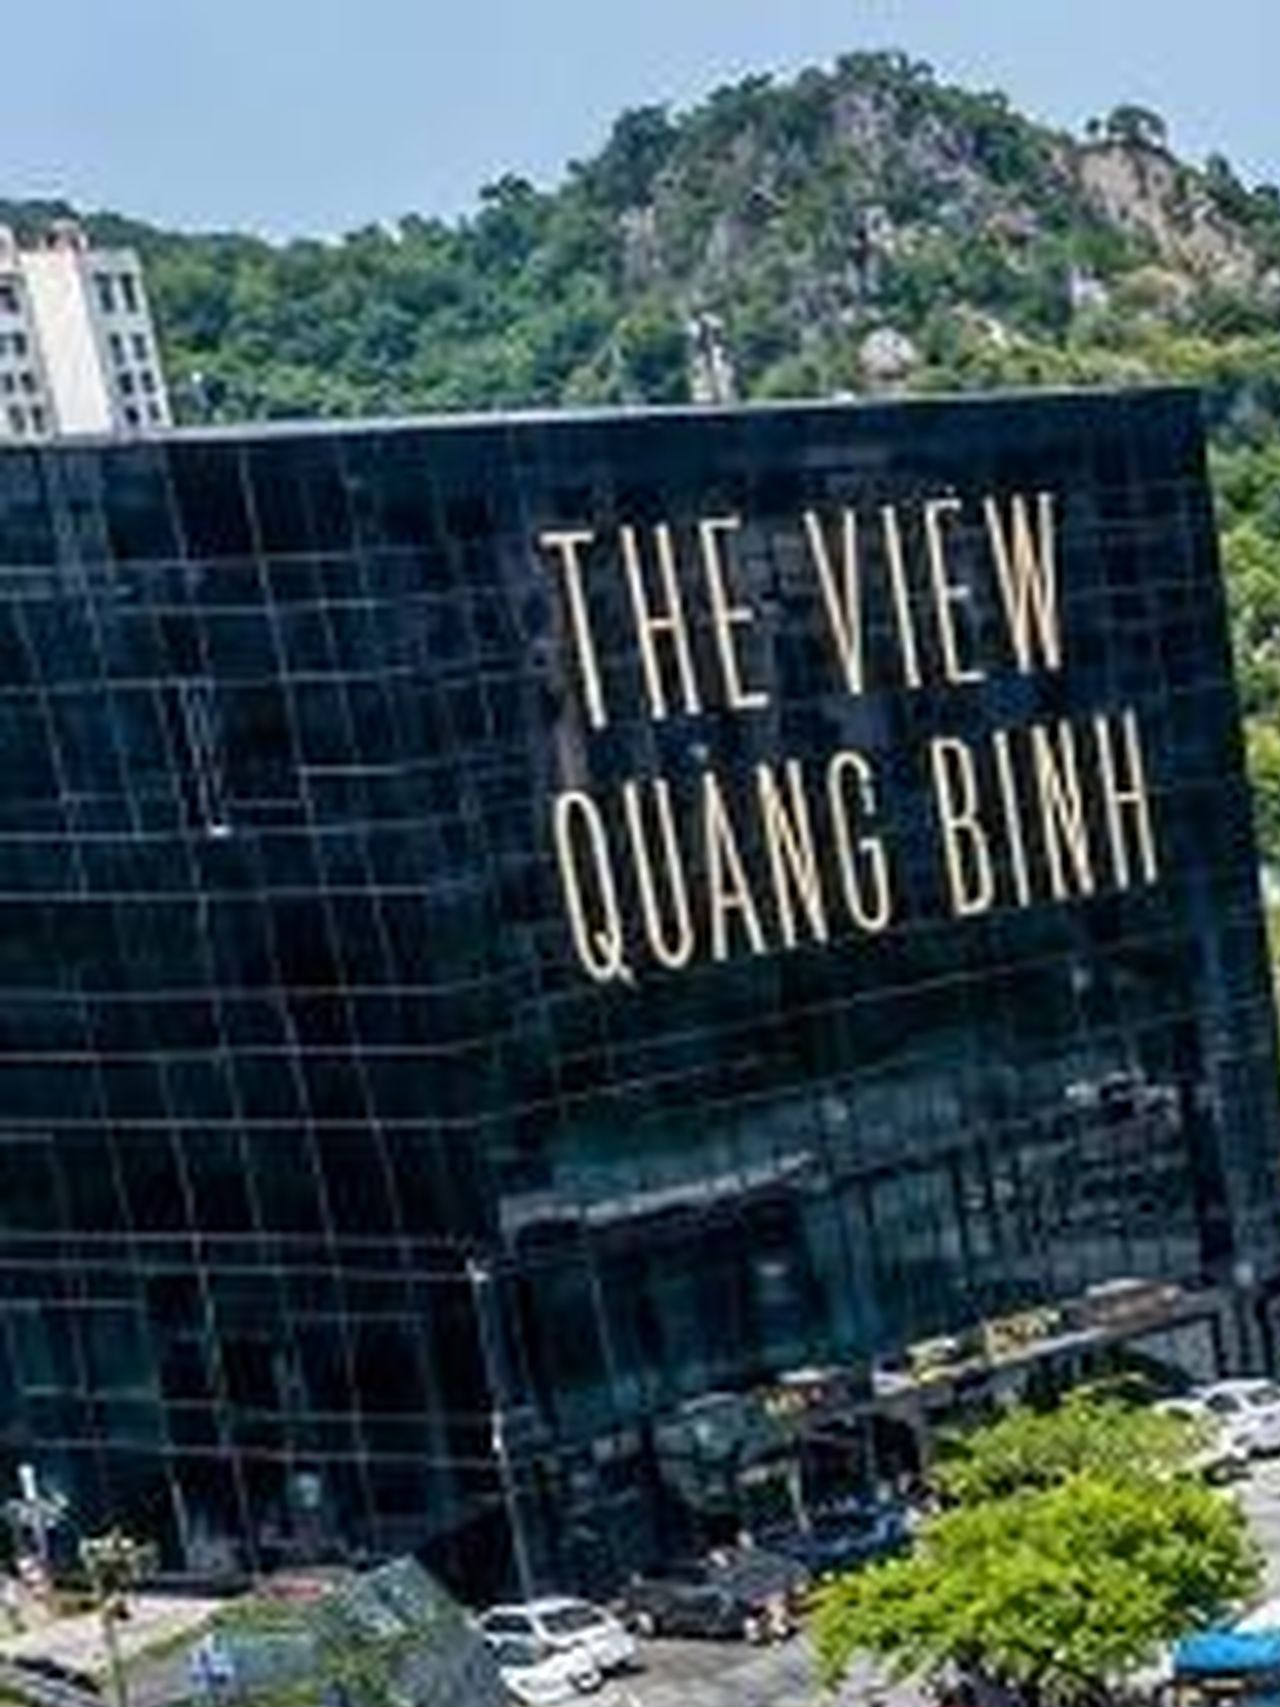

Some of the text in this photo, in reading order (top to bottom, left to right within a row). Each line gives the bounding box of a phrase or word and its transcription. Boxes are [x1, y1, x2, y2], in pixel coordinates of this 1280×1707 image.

[540, 492, 1062, 729] THE VIEW
[931, 707, 1158, 918] BINH
